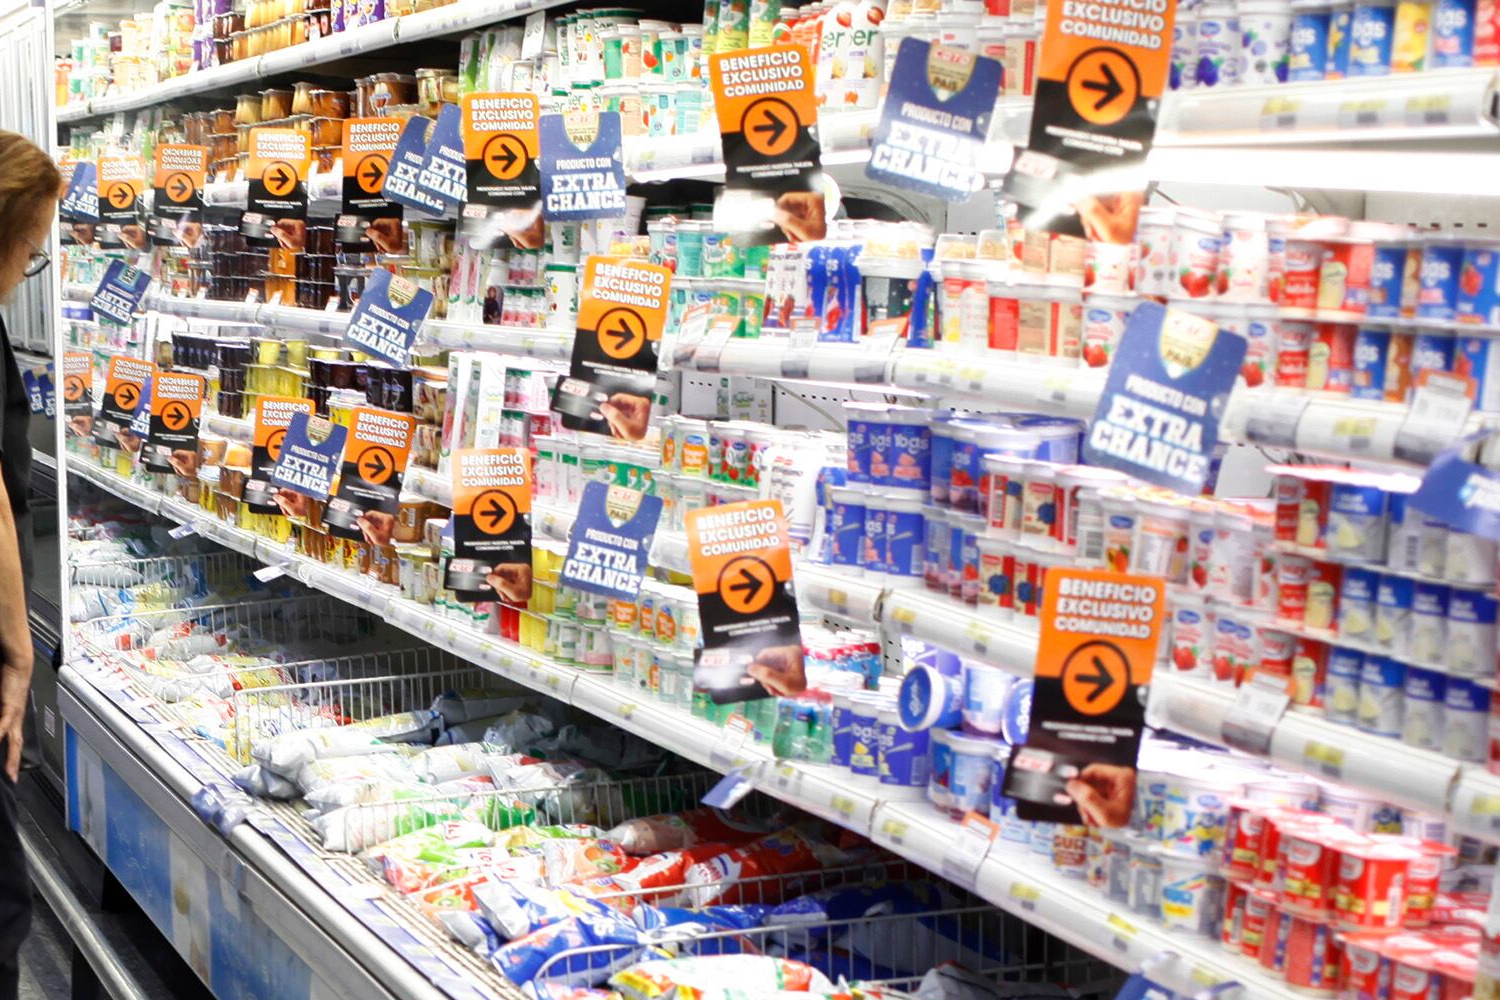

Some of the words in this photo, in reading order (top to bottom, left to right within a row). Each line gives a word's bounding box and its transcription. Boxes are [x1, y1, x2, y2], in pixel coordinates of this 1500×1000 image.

[1063, 1, 1165, 32] EXCLUSIVO
[852, 29, 879, 47] er
[1060, 20, 1162, 49] COMUNIDAD
[720, 51, 800, 71] BENEFICIO
[722, 65, 803, 85] EXCLUSIVO
[724, 80, 804, 97] COMUNIDAD
[471, 98, 532, 109] BENEFICIO
[472, 110, 534, 121] EXCLUSIVO
[902, 102, 952, 128] PRODUCTO
[952, 115, 973, 133] CON
[350, 123, 399, 133] BENEFICIO
[473, 121, 534, 131] COMUNIDAD
[257, 133, 306, 143] BENEFICIO
[257, 142, 305, 151] EXCLUSIVO
[350, 133, 399, 143] EXCLUSIVO
[257, 151, 305, 159] COMUNIDAD
[556, 159, 594, 170] PRODUCTO
[596, 157, 612, 168] CON
[551, 172, 619, 193] EXTRA
[547, 190, 627, 212] CHANCE
[595, 263, 664, 285] BENEFICIO
[594, 276, 662, 297] EXCLUSIVO
[592, 289, 661, 309] COMUNIDAD
[357, 312, 407, 348] EXTRA
[347, 324, 408, 363] CHANCE
[262, 410, 293, 420] EXCLUS
[263, 401, 310, 412] BENEFICIO
[262, 419, 291, 427] COMUN
[357, 422, 407, 439] EXCLUSIVO
[359, 412, 409, 430] BENEFICIO
[1107, 394, 1203, 452] EXTRA
[355, 432, 406, 449] COMUNIDAD
[461, 454, 523, 466] BENEFICIO
[1090, 420, 1208, 484] CHANCE
[283, 454, 328, 482] EXTRA
[461, 465, 524, 476] EXCLUSIVO
[274, 466, 331, 494] CHANCE
[462, 477, 524, 487] COMUNIDAD
[696, 507, 775, 530] BENEFICIO
[585, 528, 622, 546] PRODUCTO
[699, 522, 777, 544] EXCLUSIVO
[701, 537, 780, 557] COMUNIDAD
[574, 542, 637, 575] EXTRA
[564, 559, 642, 594] CHANCE
[1059, 578, 1156, 603] BENEFICIO
[1057, 597, 1154, 622] EXCLUSIVO
[1055, 617, 1151, 639] COMUNIDAD
